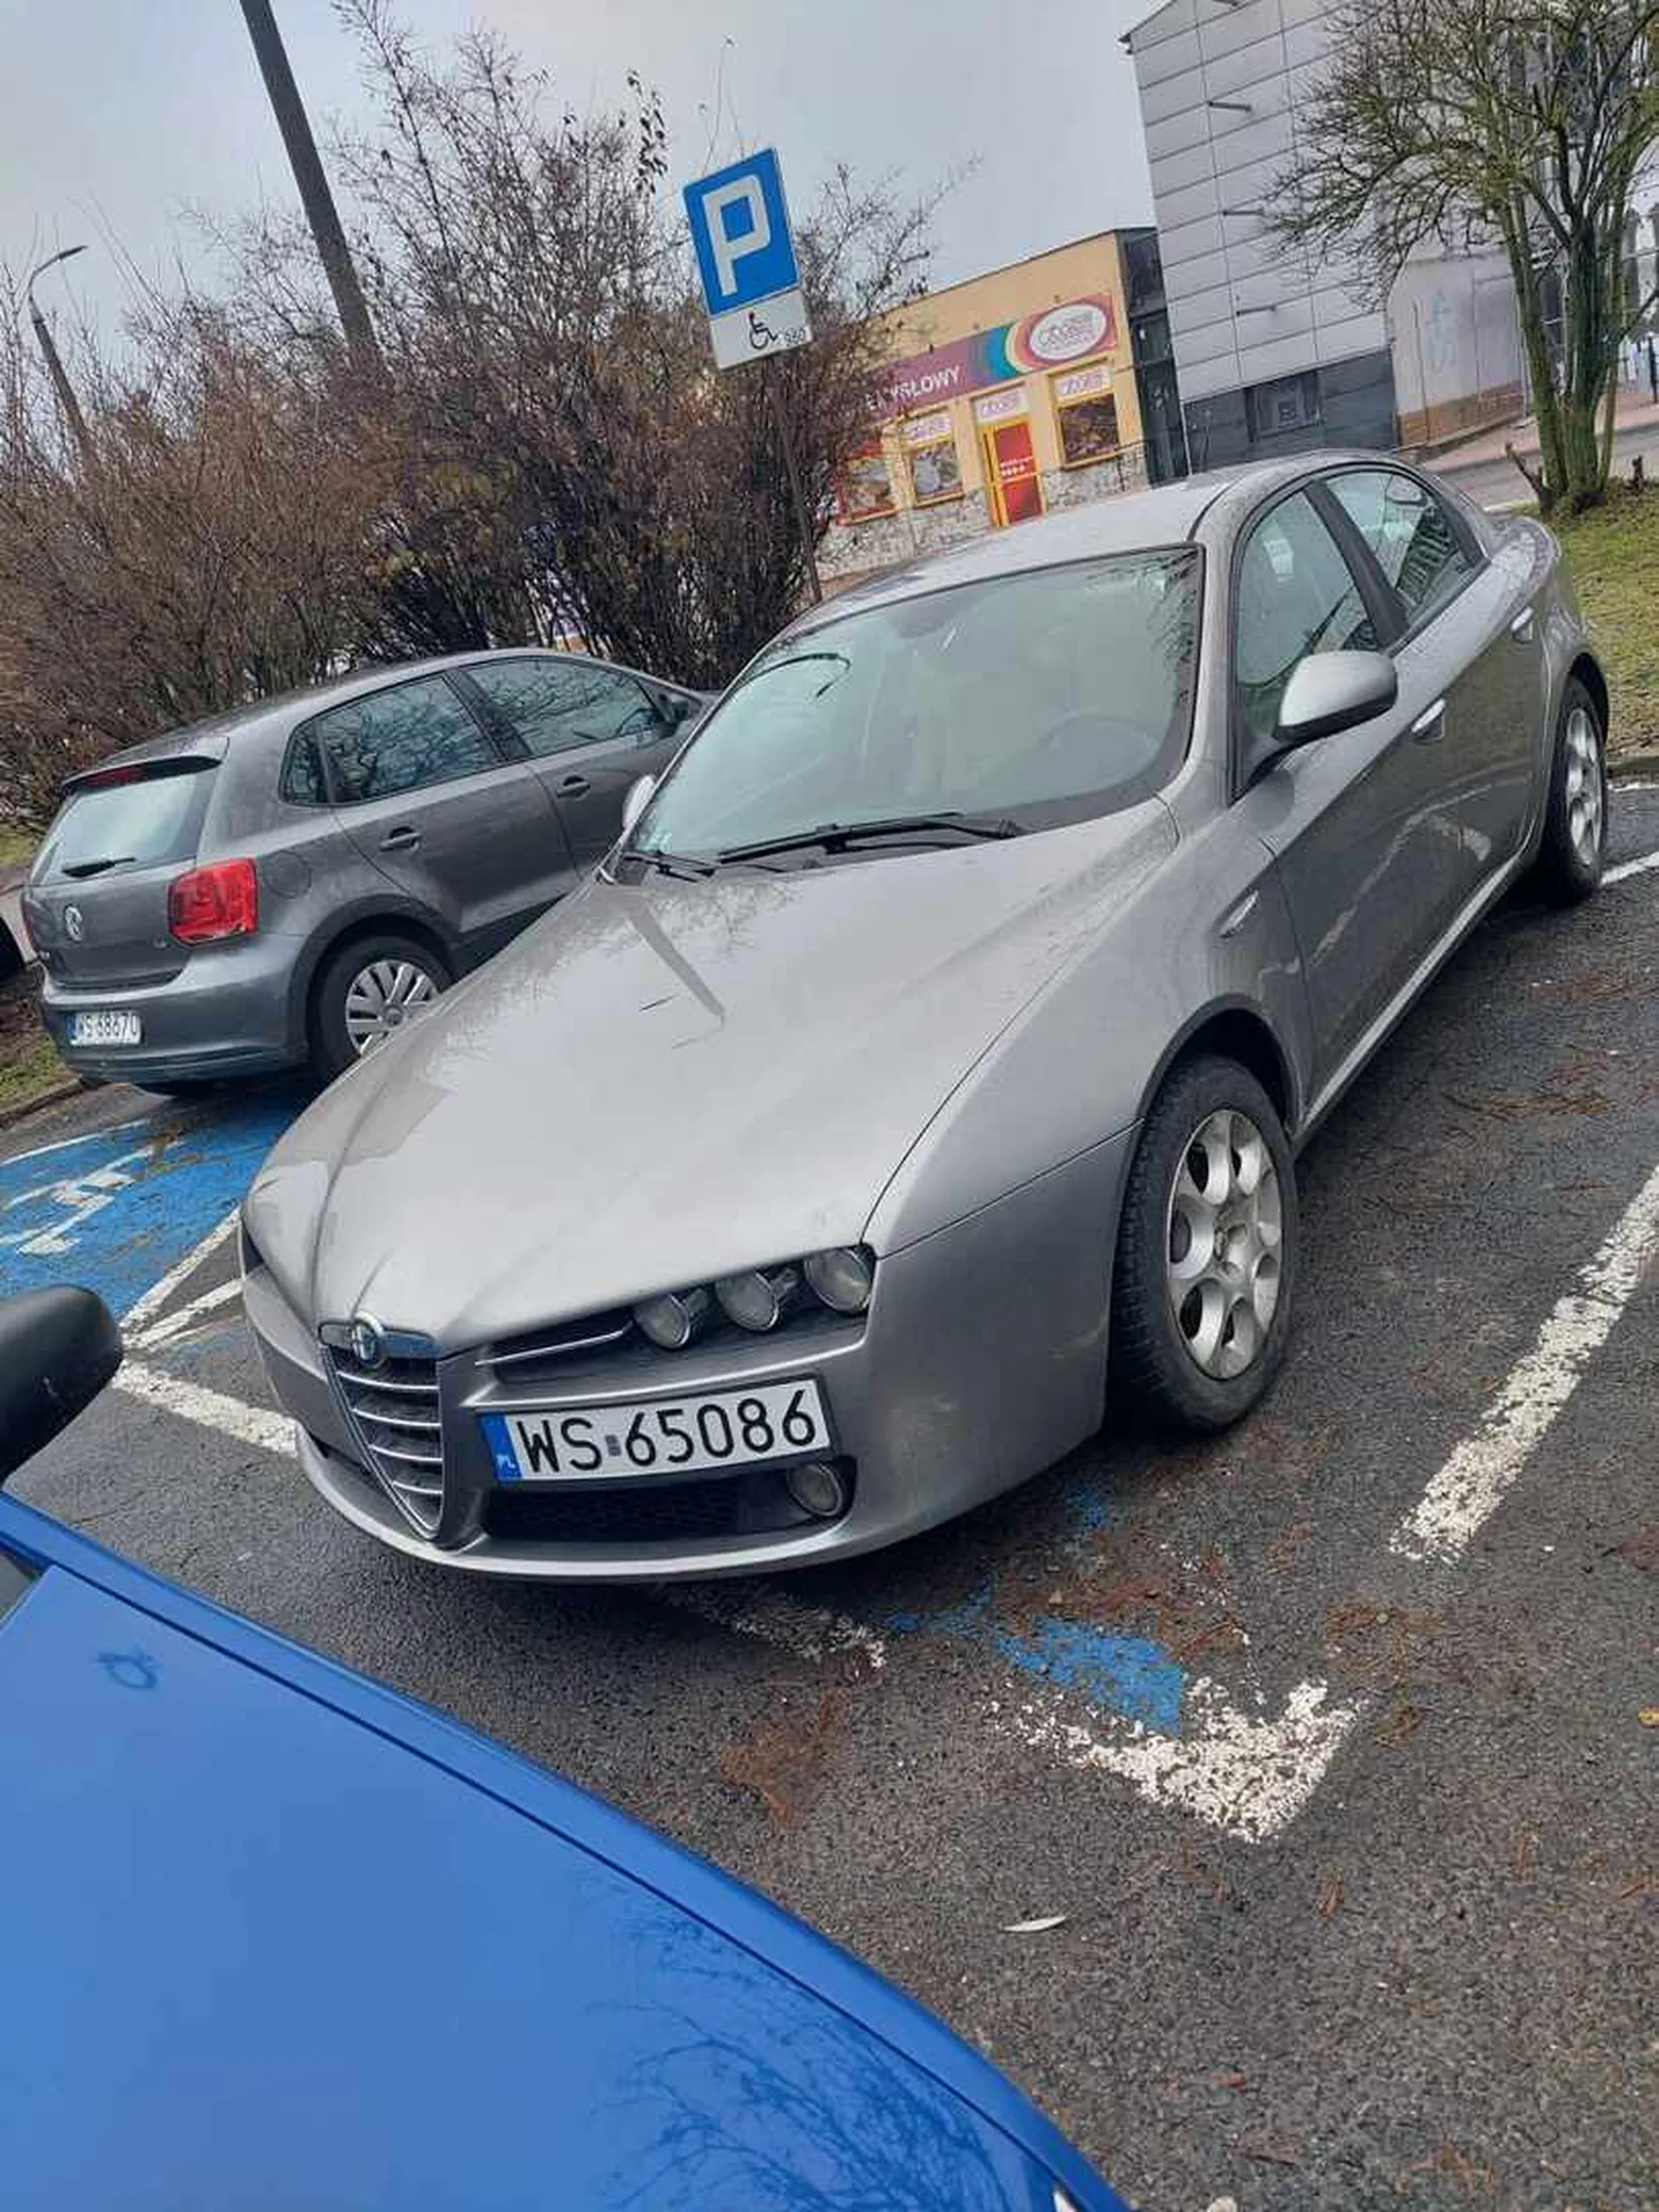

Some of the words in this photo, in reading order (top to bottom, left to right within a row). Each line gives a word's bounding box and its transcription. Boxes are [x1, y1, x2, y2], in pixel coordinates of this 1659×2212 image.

[702, 174, 771, 296] P
[517, 1417, 603, 1473] WS
[625, 1388, 817, 1468] 65086
